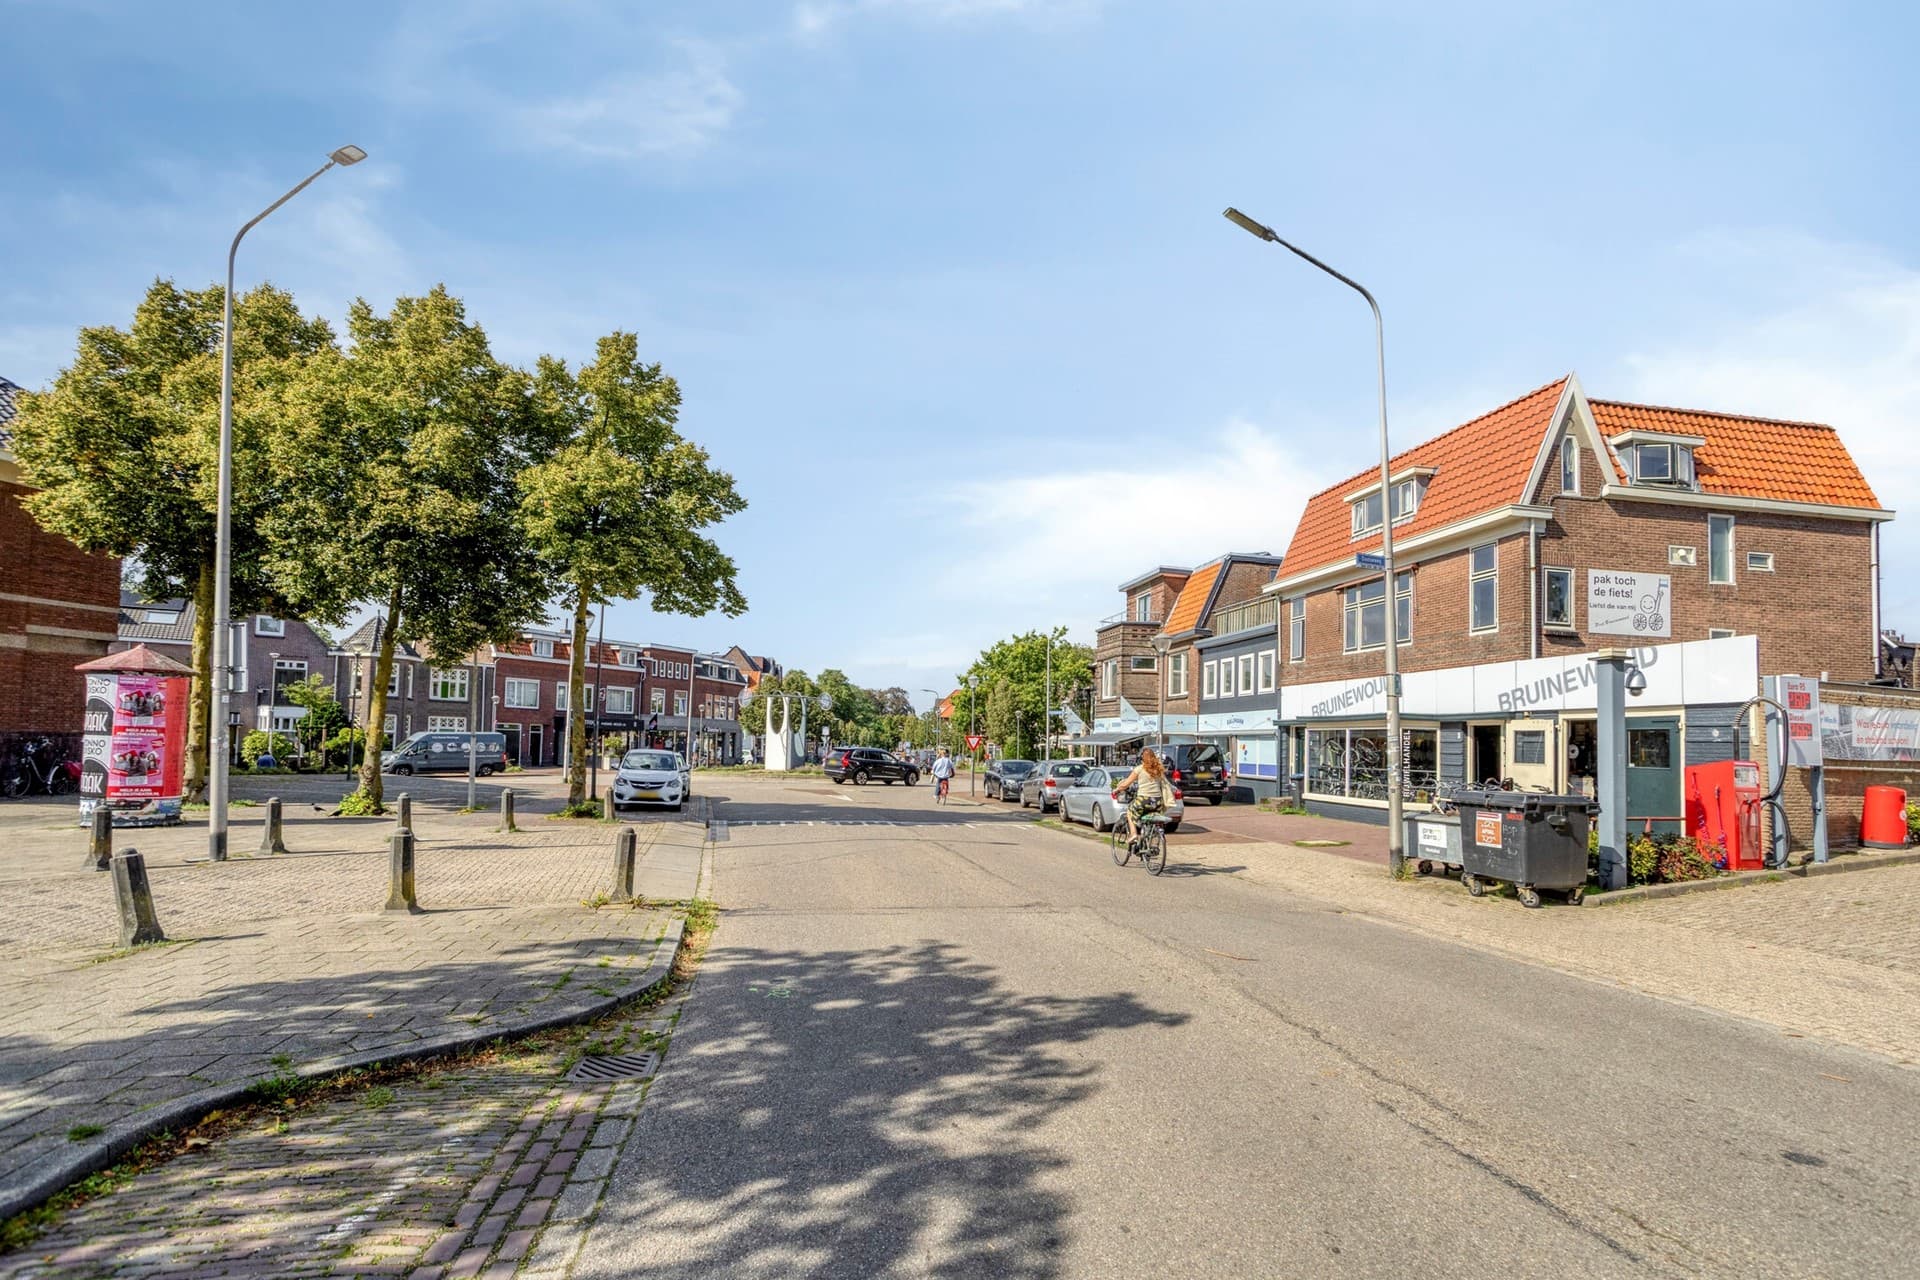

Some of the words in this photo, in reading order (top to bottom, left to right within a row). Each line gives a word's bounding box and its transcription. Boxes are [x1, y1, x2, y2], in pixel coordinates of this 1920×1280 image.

[1593, 574, 1611, 585] pak
[1614, 575, 1636, 586] toch
[1593, 587, 1606, 597] de
[1609, 588, 1633, 599] fiets!
[1311, 677, 1388, 717] BRUINEWOU
